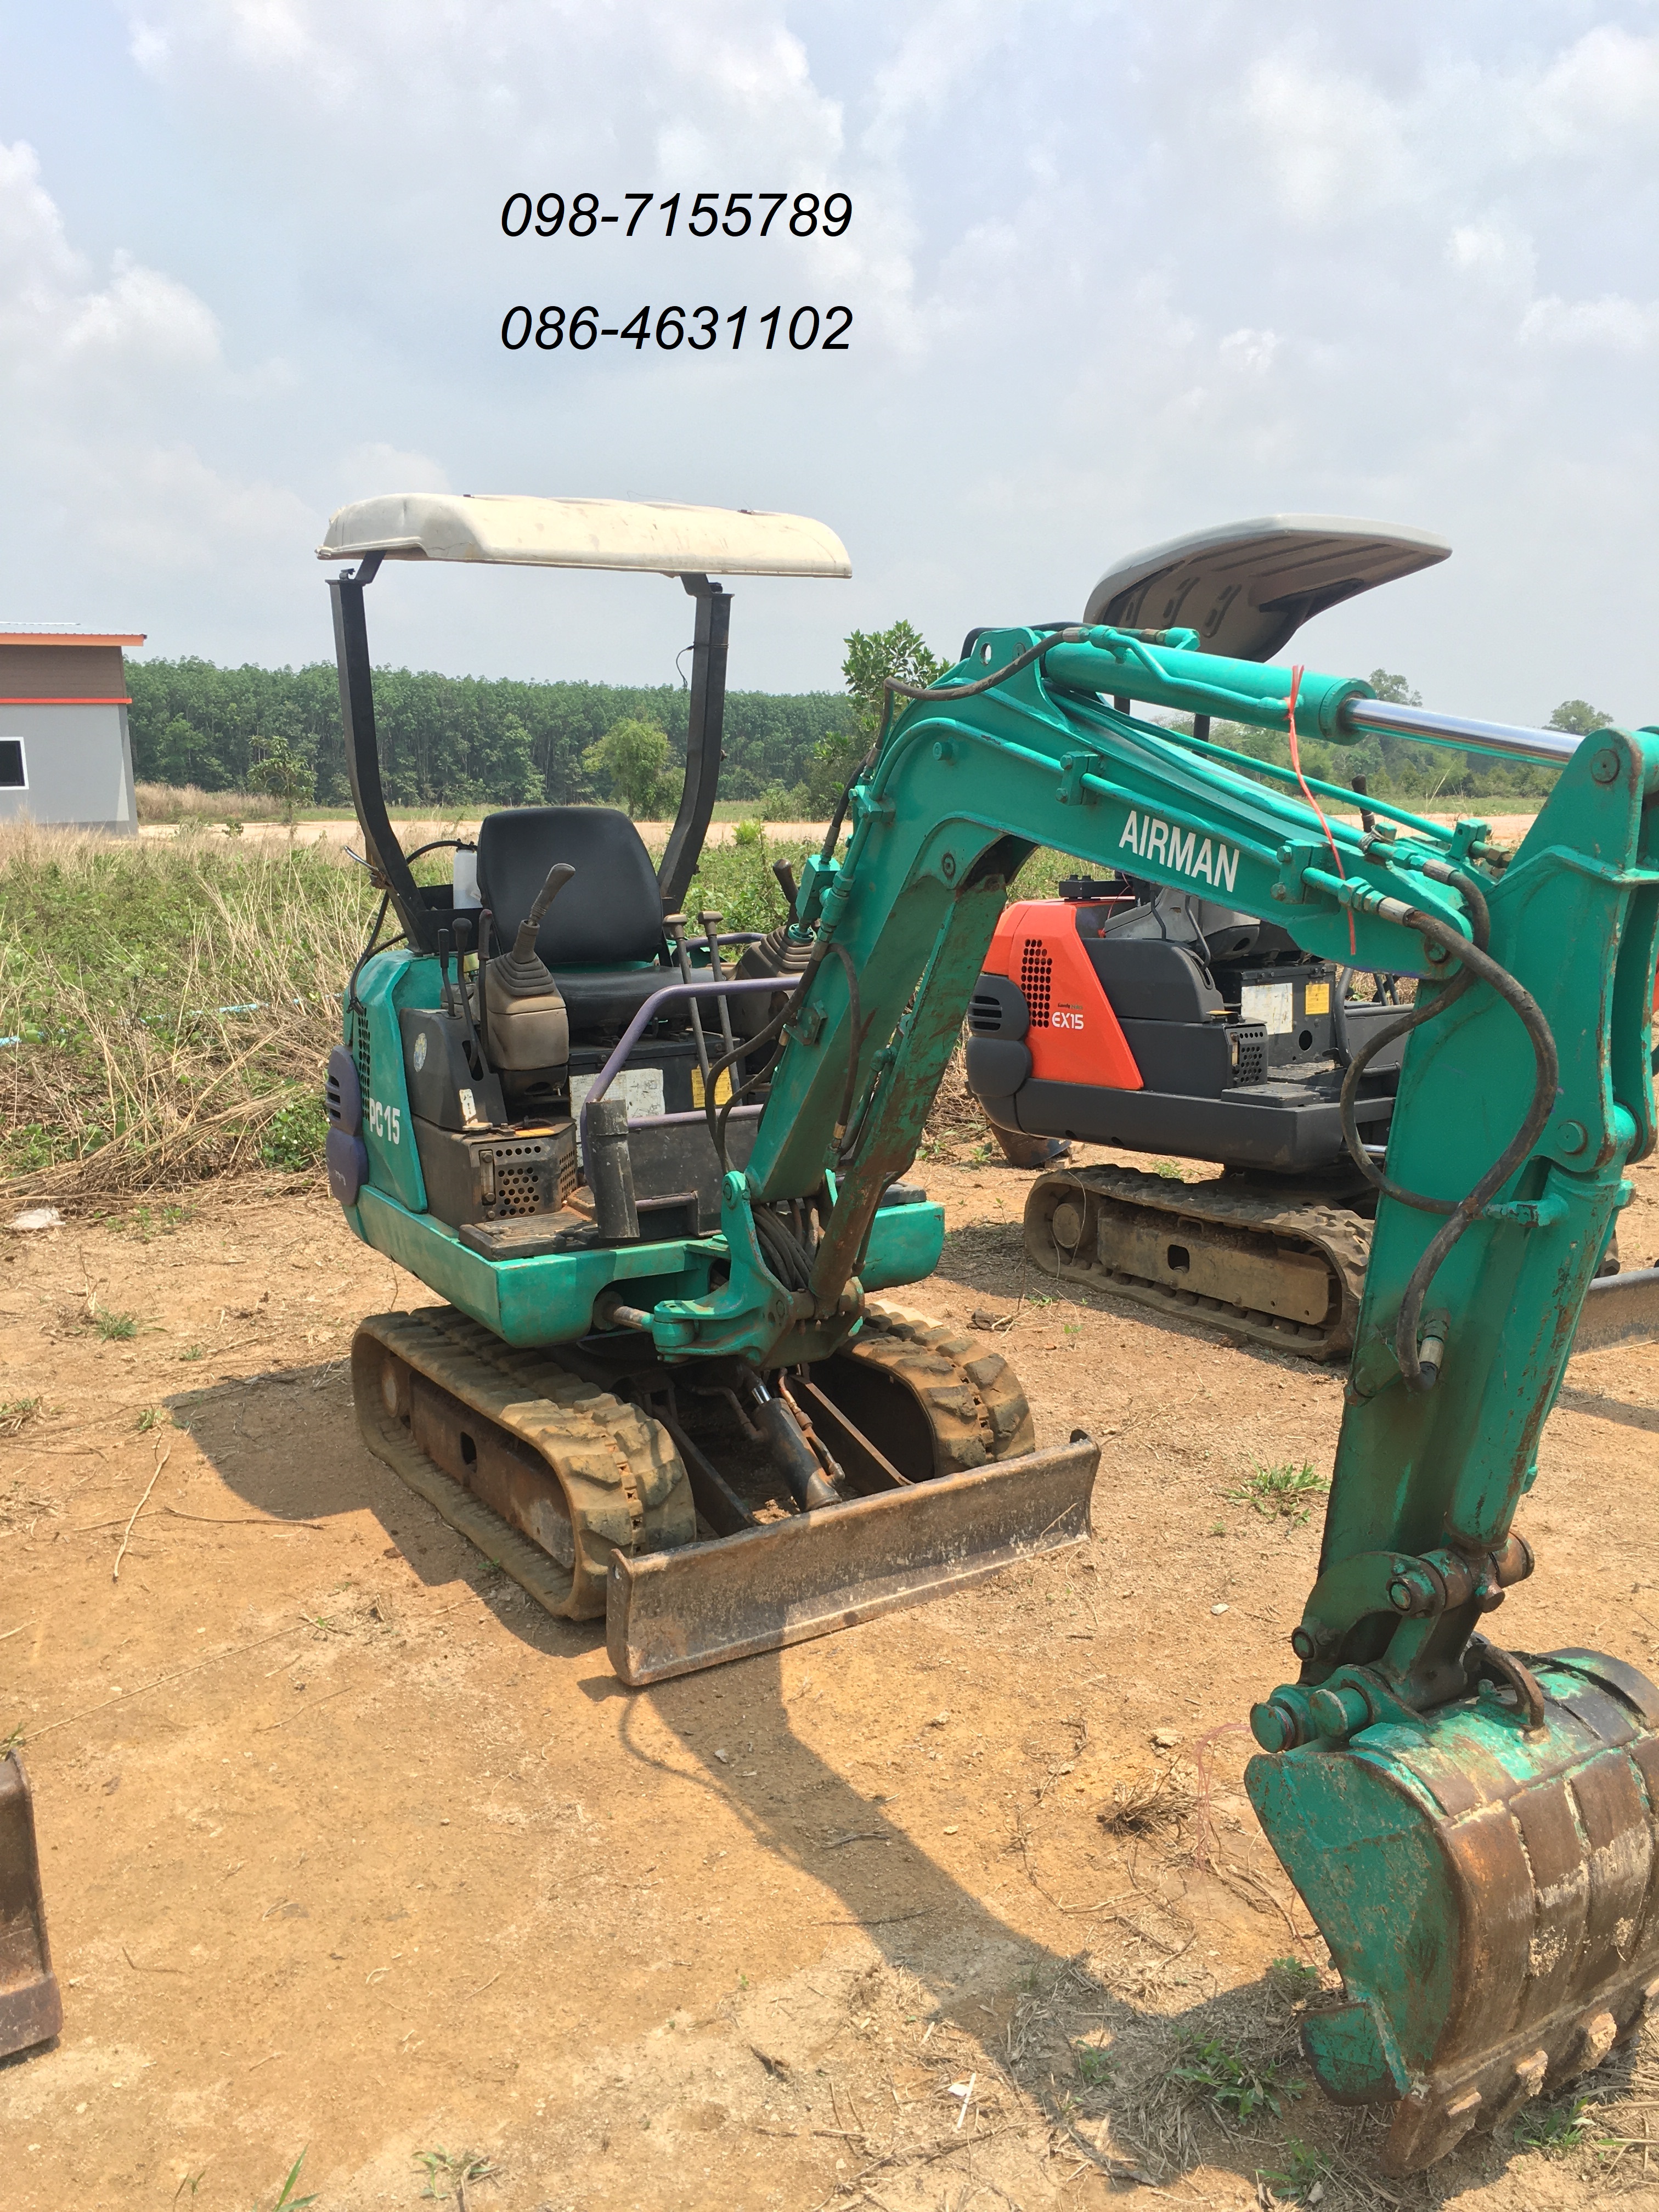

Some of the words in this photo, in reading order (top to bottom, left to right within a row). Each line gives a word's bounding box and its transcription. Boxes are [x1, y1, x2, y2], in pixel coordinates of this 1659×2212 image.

[1119, 810, 1239, 893] AIRMAN
[1052, 1012, 1084, 1030] EX15
[369, 1097, 400, 1145] PC15
